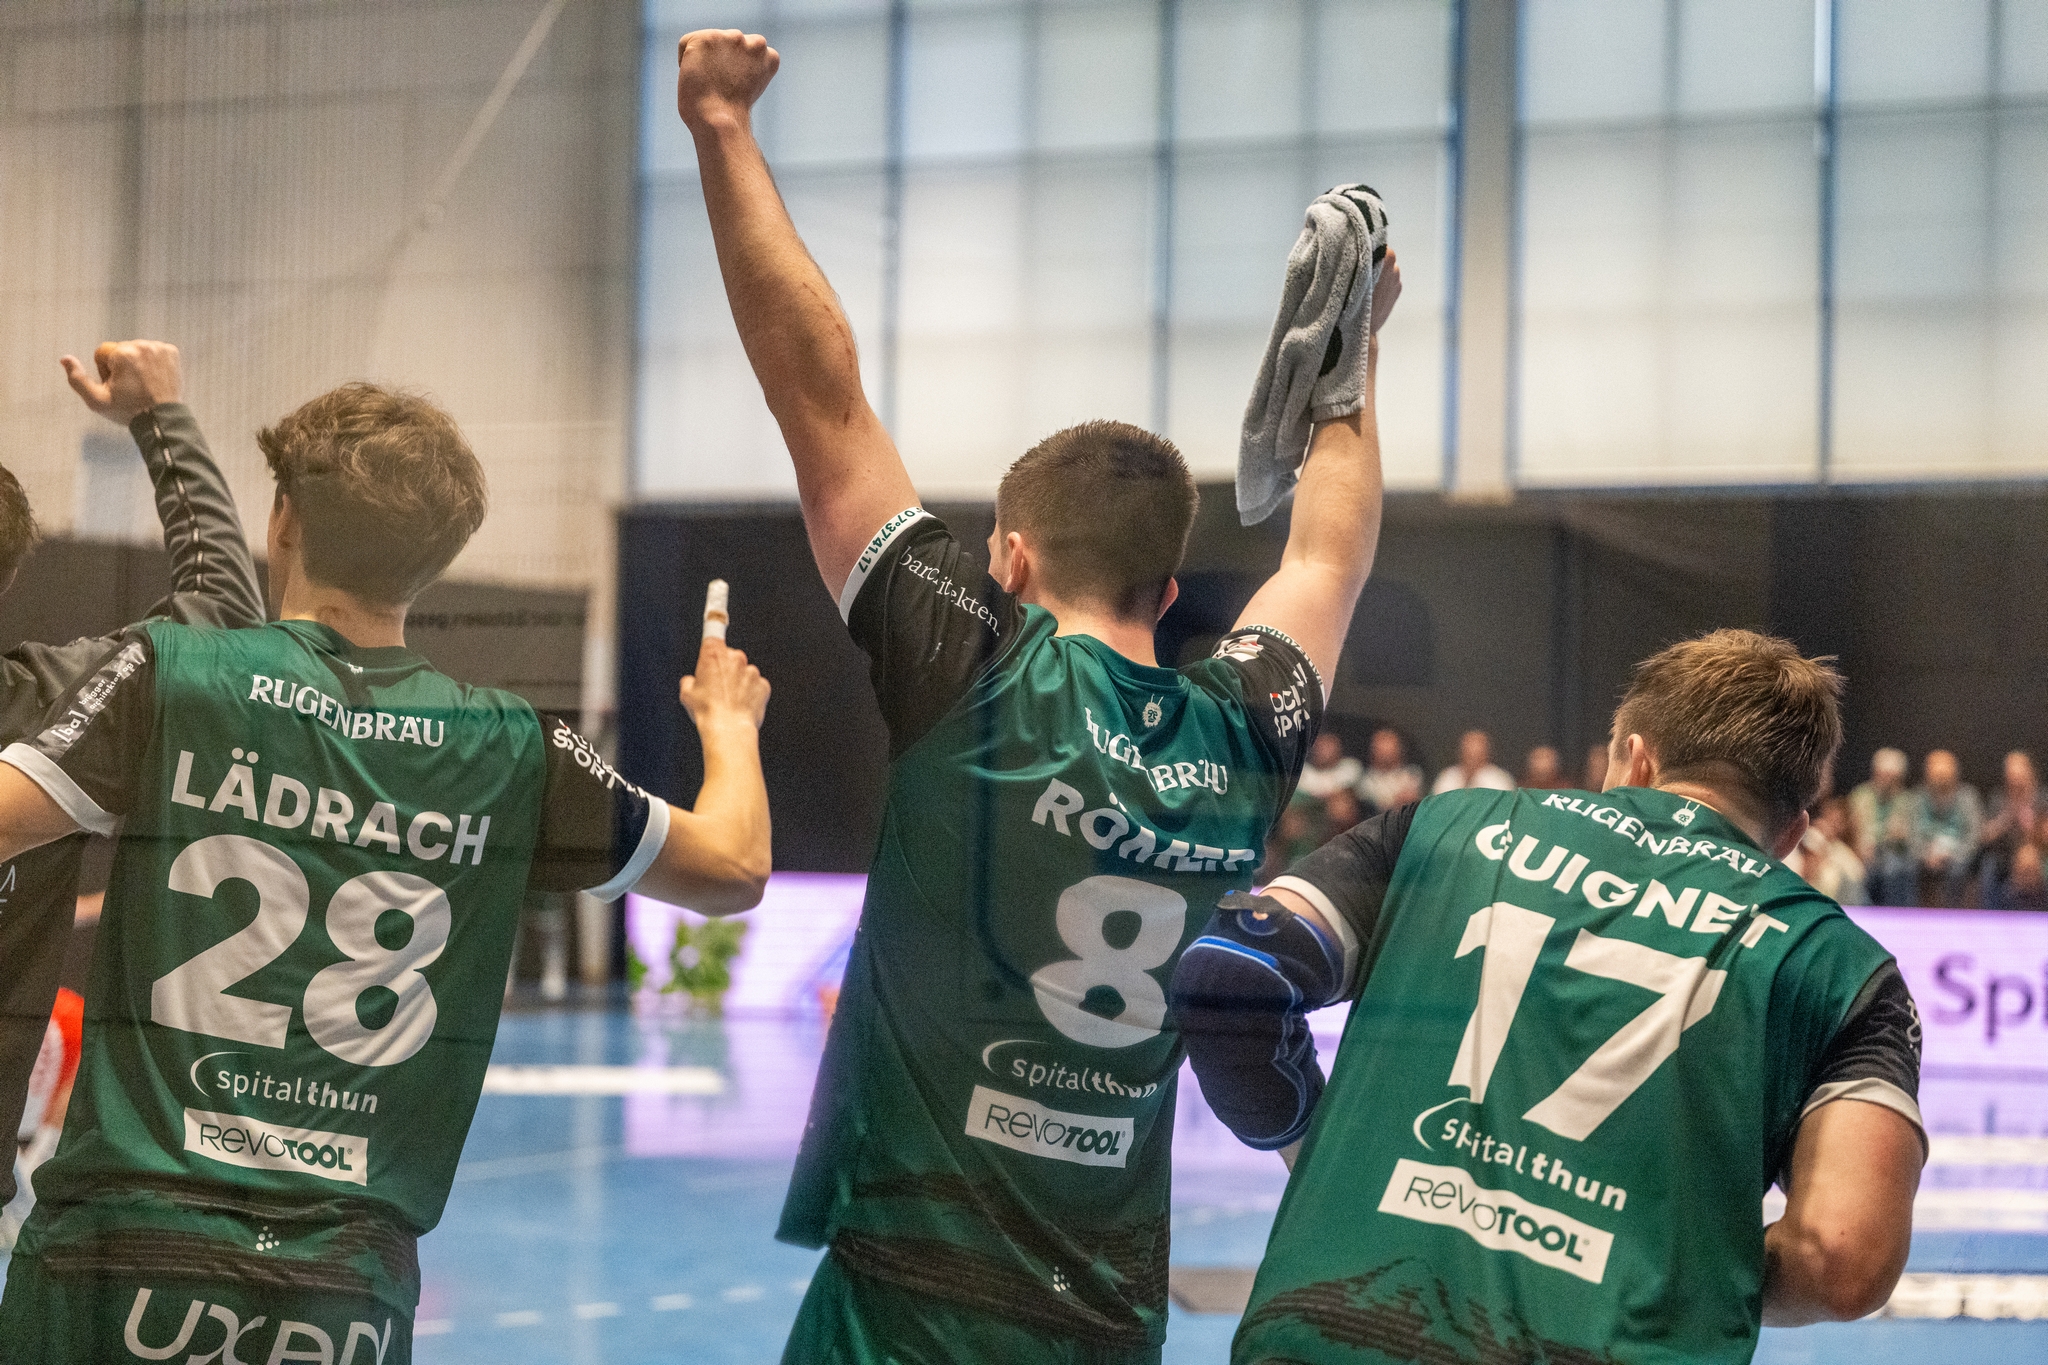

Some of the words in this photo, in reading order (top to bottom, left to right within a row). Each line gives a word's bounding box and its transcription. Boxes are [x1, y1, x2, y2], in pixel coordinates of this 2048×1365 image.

[248, 674, 445, 748] RUGENBRÄU
[171, 747, 491, 866] LÄDRACH
[1541, 793, 1772, 879] RUGENBRÄU
[1474, 818, 1790, 949] GUIGNET
[150, 834, 453, 1067] 28
[1030, 874, 1188, 1049] 8
[1447, 901, 1728, 1142] 17
[216, 1069, 379, 1114] spitalthun
